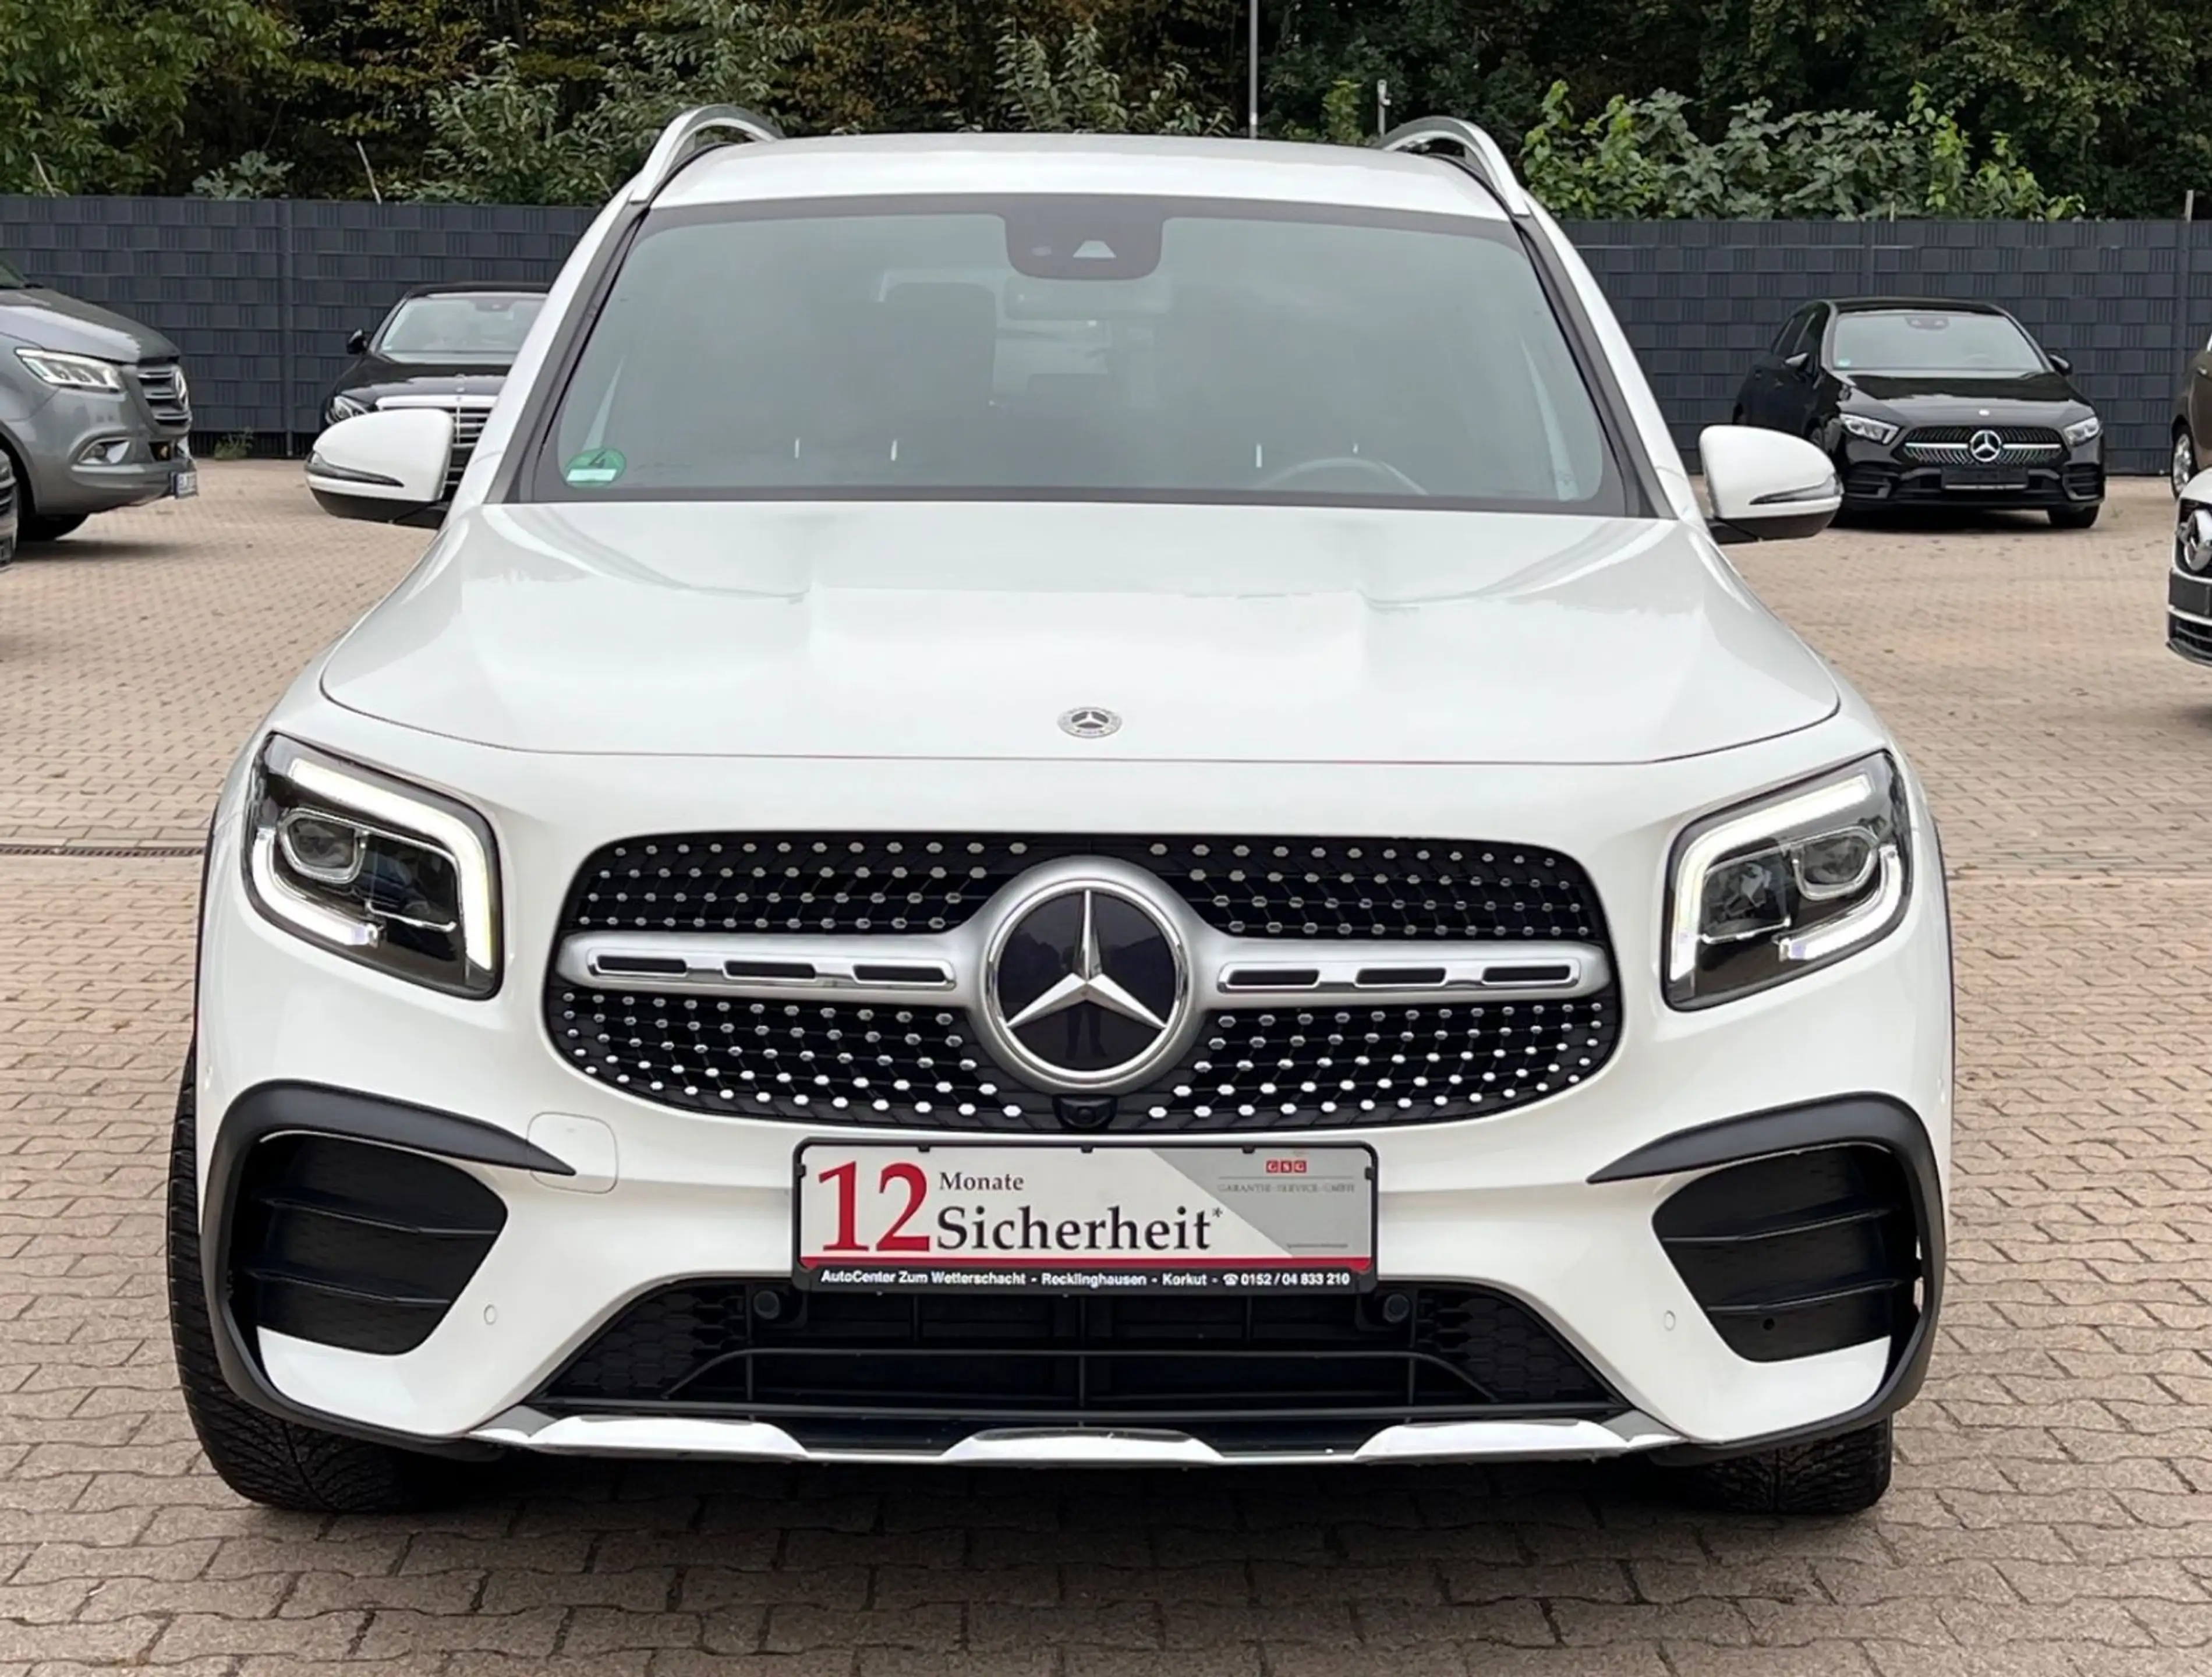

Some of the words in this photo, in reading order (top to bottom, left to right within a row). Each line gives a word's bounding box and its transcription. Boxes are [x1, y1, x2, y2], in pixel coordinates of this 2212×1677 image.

[939, 1171, 1024, 1191] Monate
[818, 1161, 930, 1251] 12
[821, 1270, 896, 1283] AutoCenter
[898, 1271, 928, 1283] Zum
[931, 1271, 1025, 1285] Wetterschacht
[1041, 1272, 1146, 1288] Recklinghausen
[1163, 1273, 1207, 1286] Korkut
[1241, 1273, 1272, 1286] 0152
[1282, 1273, 1297, 1286] 04
[1300, 1273, 1324, 1286] 833
[1326, 1273, 1350, 1285] 210
